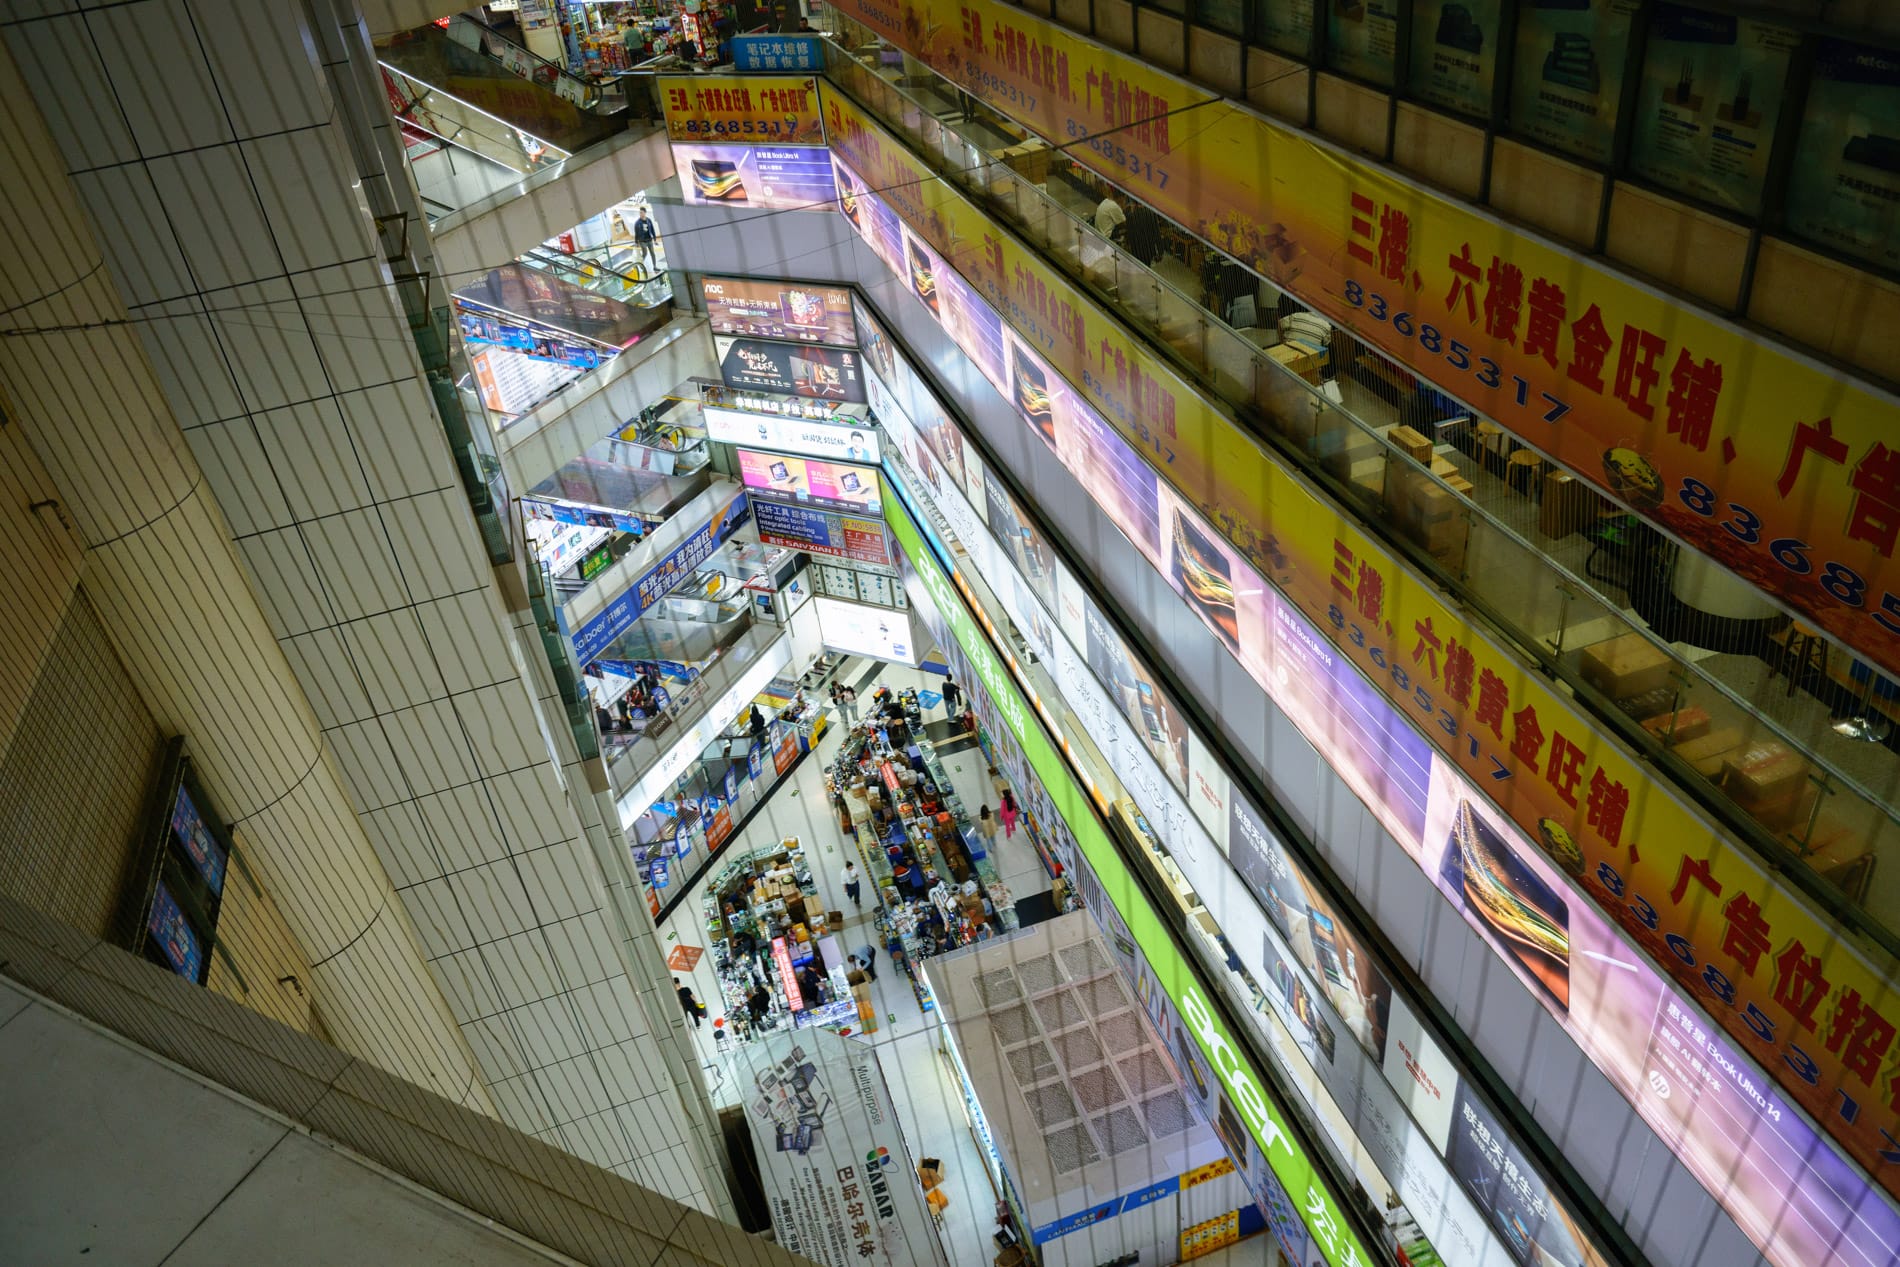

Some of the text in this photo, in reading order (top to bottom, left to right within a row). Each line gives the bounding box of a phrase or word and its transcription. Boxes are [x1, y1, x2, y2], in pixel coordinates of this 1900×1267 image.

[746, 42, 809, 57] 笔记本维修
[748, 55, 811, 69] 数据恢复
[668, 87, 809, 113] 三楼、六楼黄金旺铺、广告位招租
[965, 61, 1037, 114] 83685317
[685, 119, 799, 135] 83685317
[1066, 118, 1170, 191] 83685317
[704, 284, 724, 295] AOC
[1344, 279, 1573, 425] 83685317
[756, 504, 826, 524] 光纤工具 综合布线
[918, 546, 962, 627] acer
[1327, 603, 1514, 782] 83685317
[652, 717, 672, 733] SONY
[1331, 537, 1900, 1117] 三楼、六楼黄金旺铺、广告位招
[1183, 987, 1294, 1157] acer
[1666, 1000, 1709, 1050] 惠普星
[1706, 1042, 1739, 1080] Book
[1736, 1074, 1768, 1110] Ultra
[1765, 1102, 1783, 1123] 14
[856, 1065, 883, 1126] Multipurpose
[865, 1160, 895, 1220] BAHAR
[1462, 1101, 1550, 1222] 联想天禧生态
[837, 1165, 877, 1259] 巴哈尔壳体
